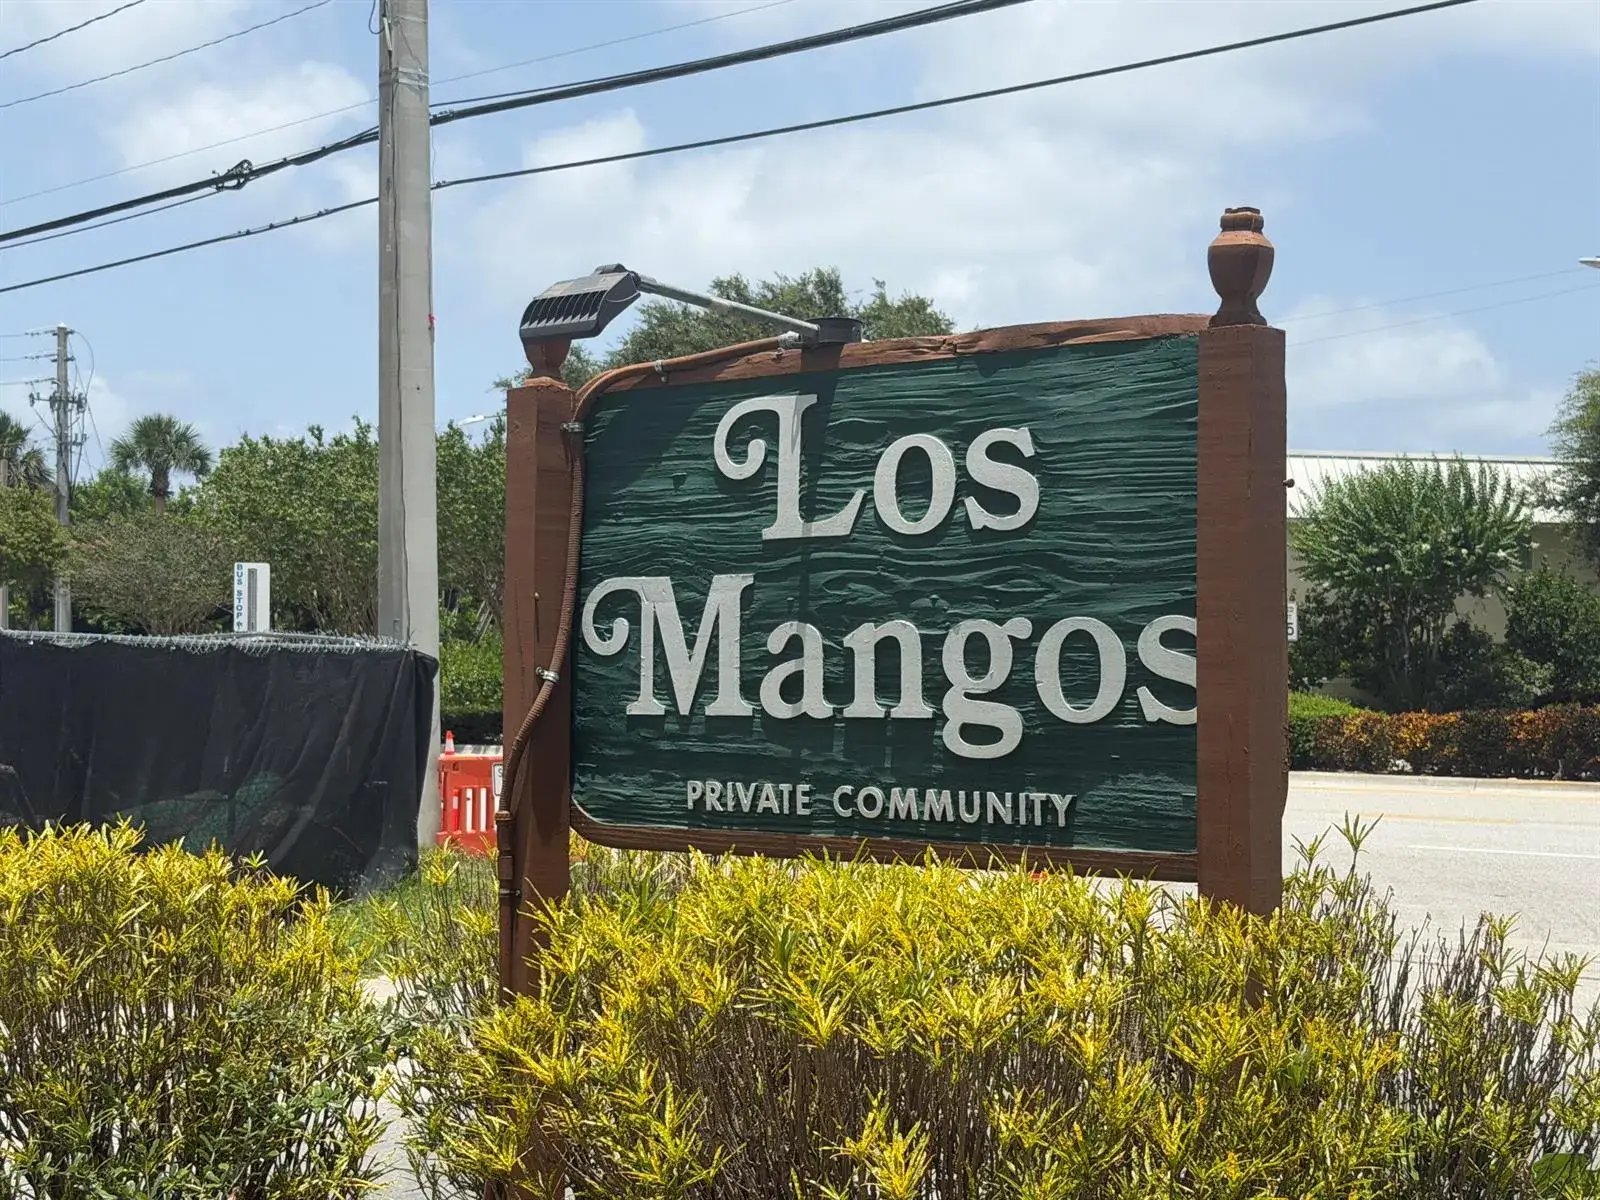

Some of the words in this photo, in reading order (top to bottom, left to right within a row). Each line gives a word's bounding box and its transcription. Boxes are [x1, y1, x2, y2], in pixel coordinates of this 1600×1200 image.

[713, 393, 1040, 540] Los
[236, 563, 244, 586] BUS
[235, 589, 244, 620] STOP
[581, 573, 1198, 759] Mangos
[686, 780, 815, 816] PRIVATE
[832, 784, 1075, 828] COMMUNITY
